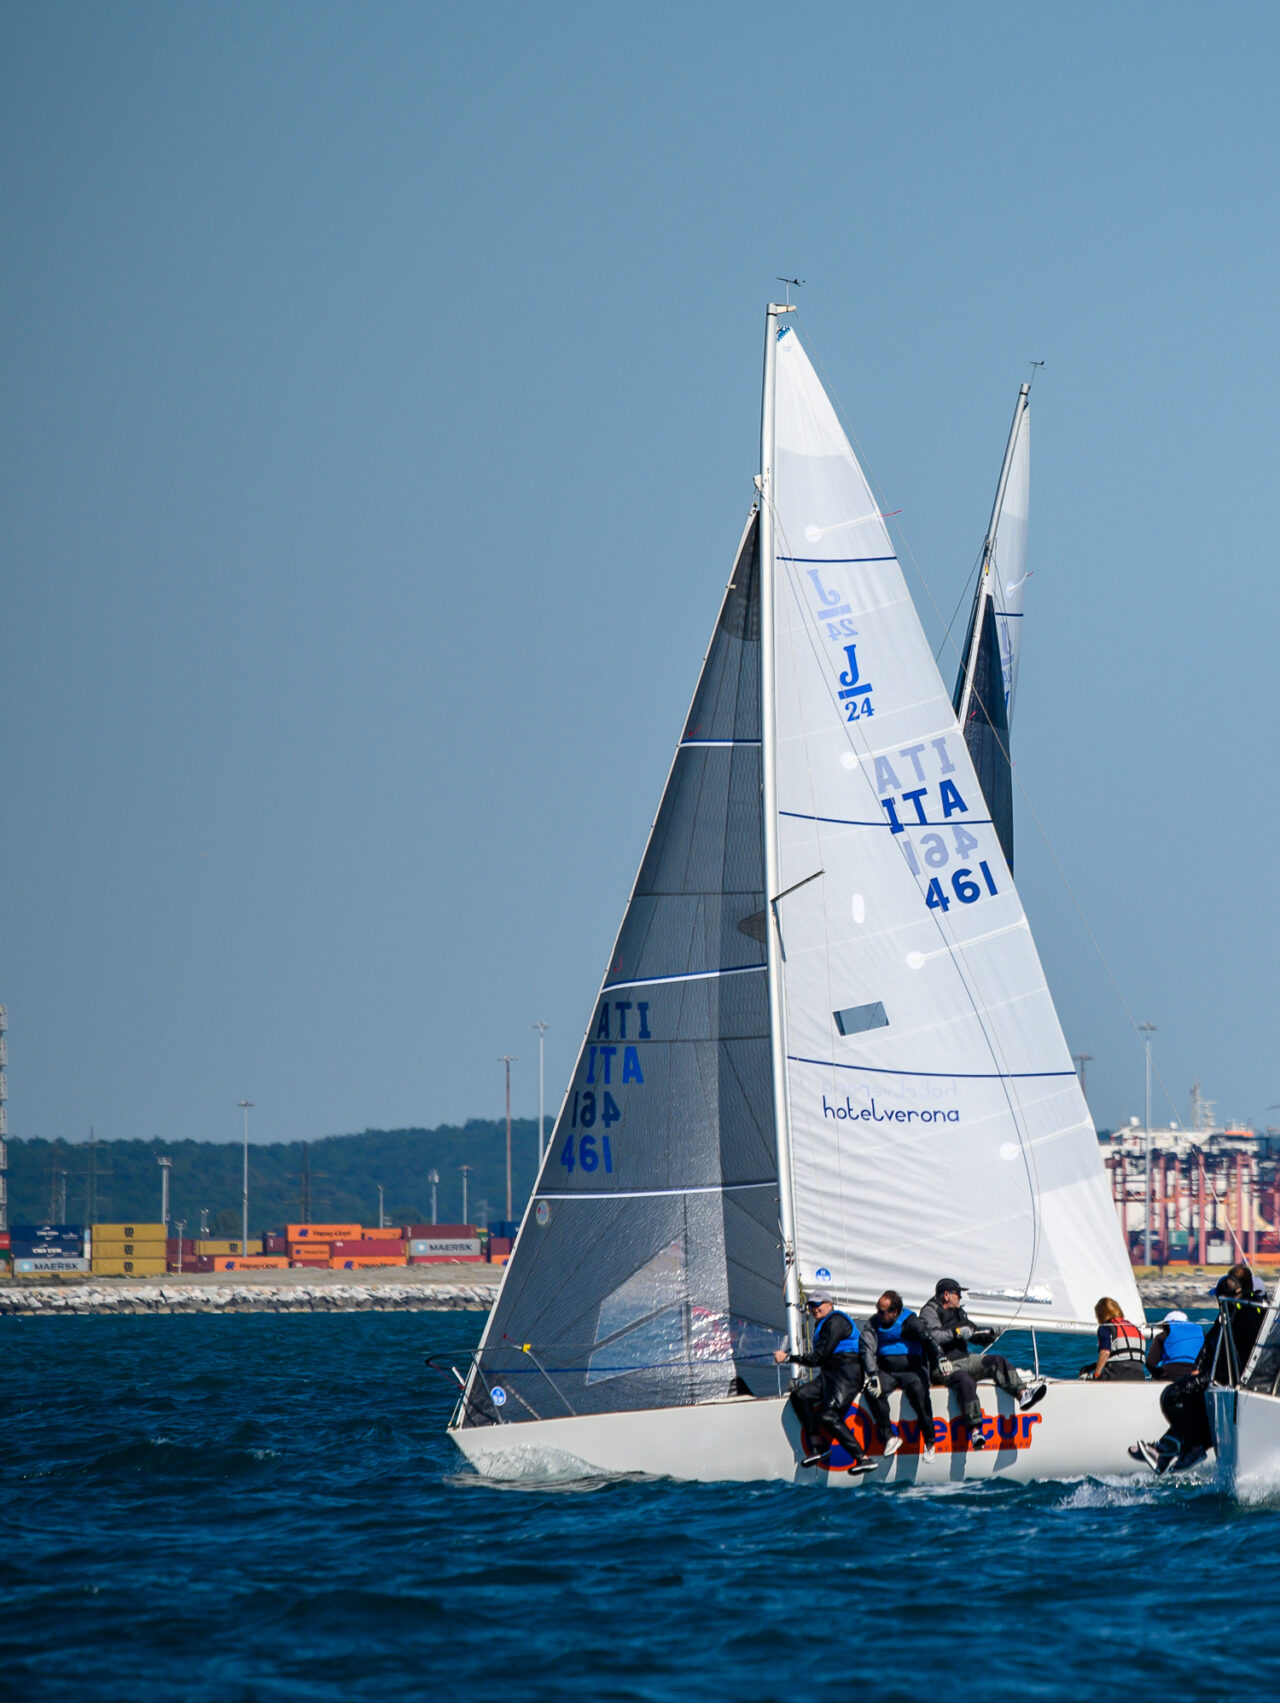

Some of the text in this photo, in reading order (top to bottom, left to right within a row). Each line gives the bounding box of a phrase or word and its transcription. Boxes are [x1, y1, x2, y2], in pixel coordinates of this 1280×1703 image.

[838, 644, 858, 688] J
[844, 697, 875, 722] 24
[881, 778, 968, 835] ITA
[925, 860, 999, 913] 461
[586, 1046, 645, 1084] ITA
[822, 1095, 960, 1123] hotelverona
[560, 1134, 613, 1174] 461
[34, 1262, 79, 1271] MAERSK
[428, 1244, 473, 1252] MAERSK
